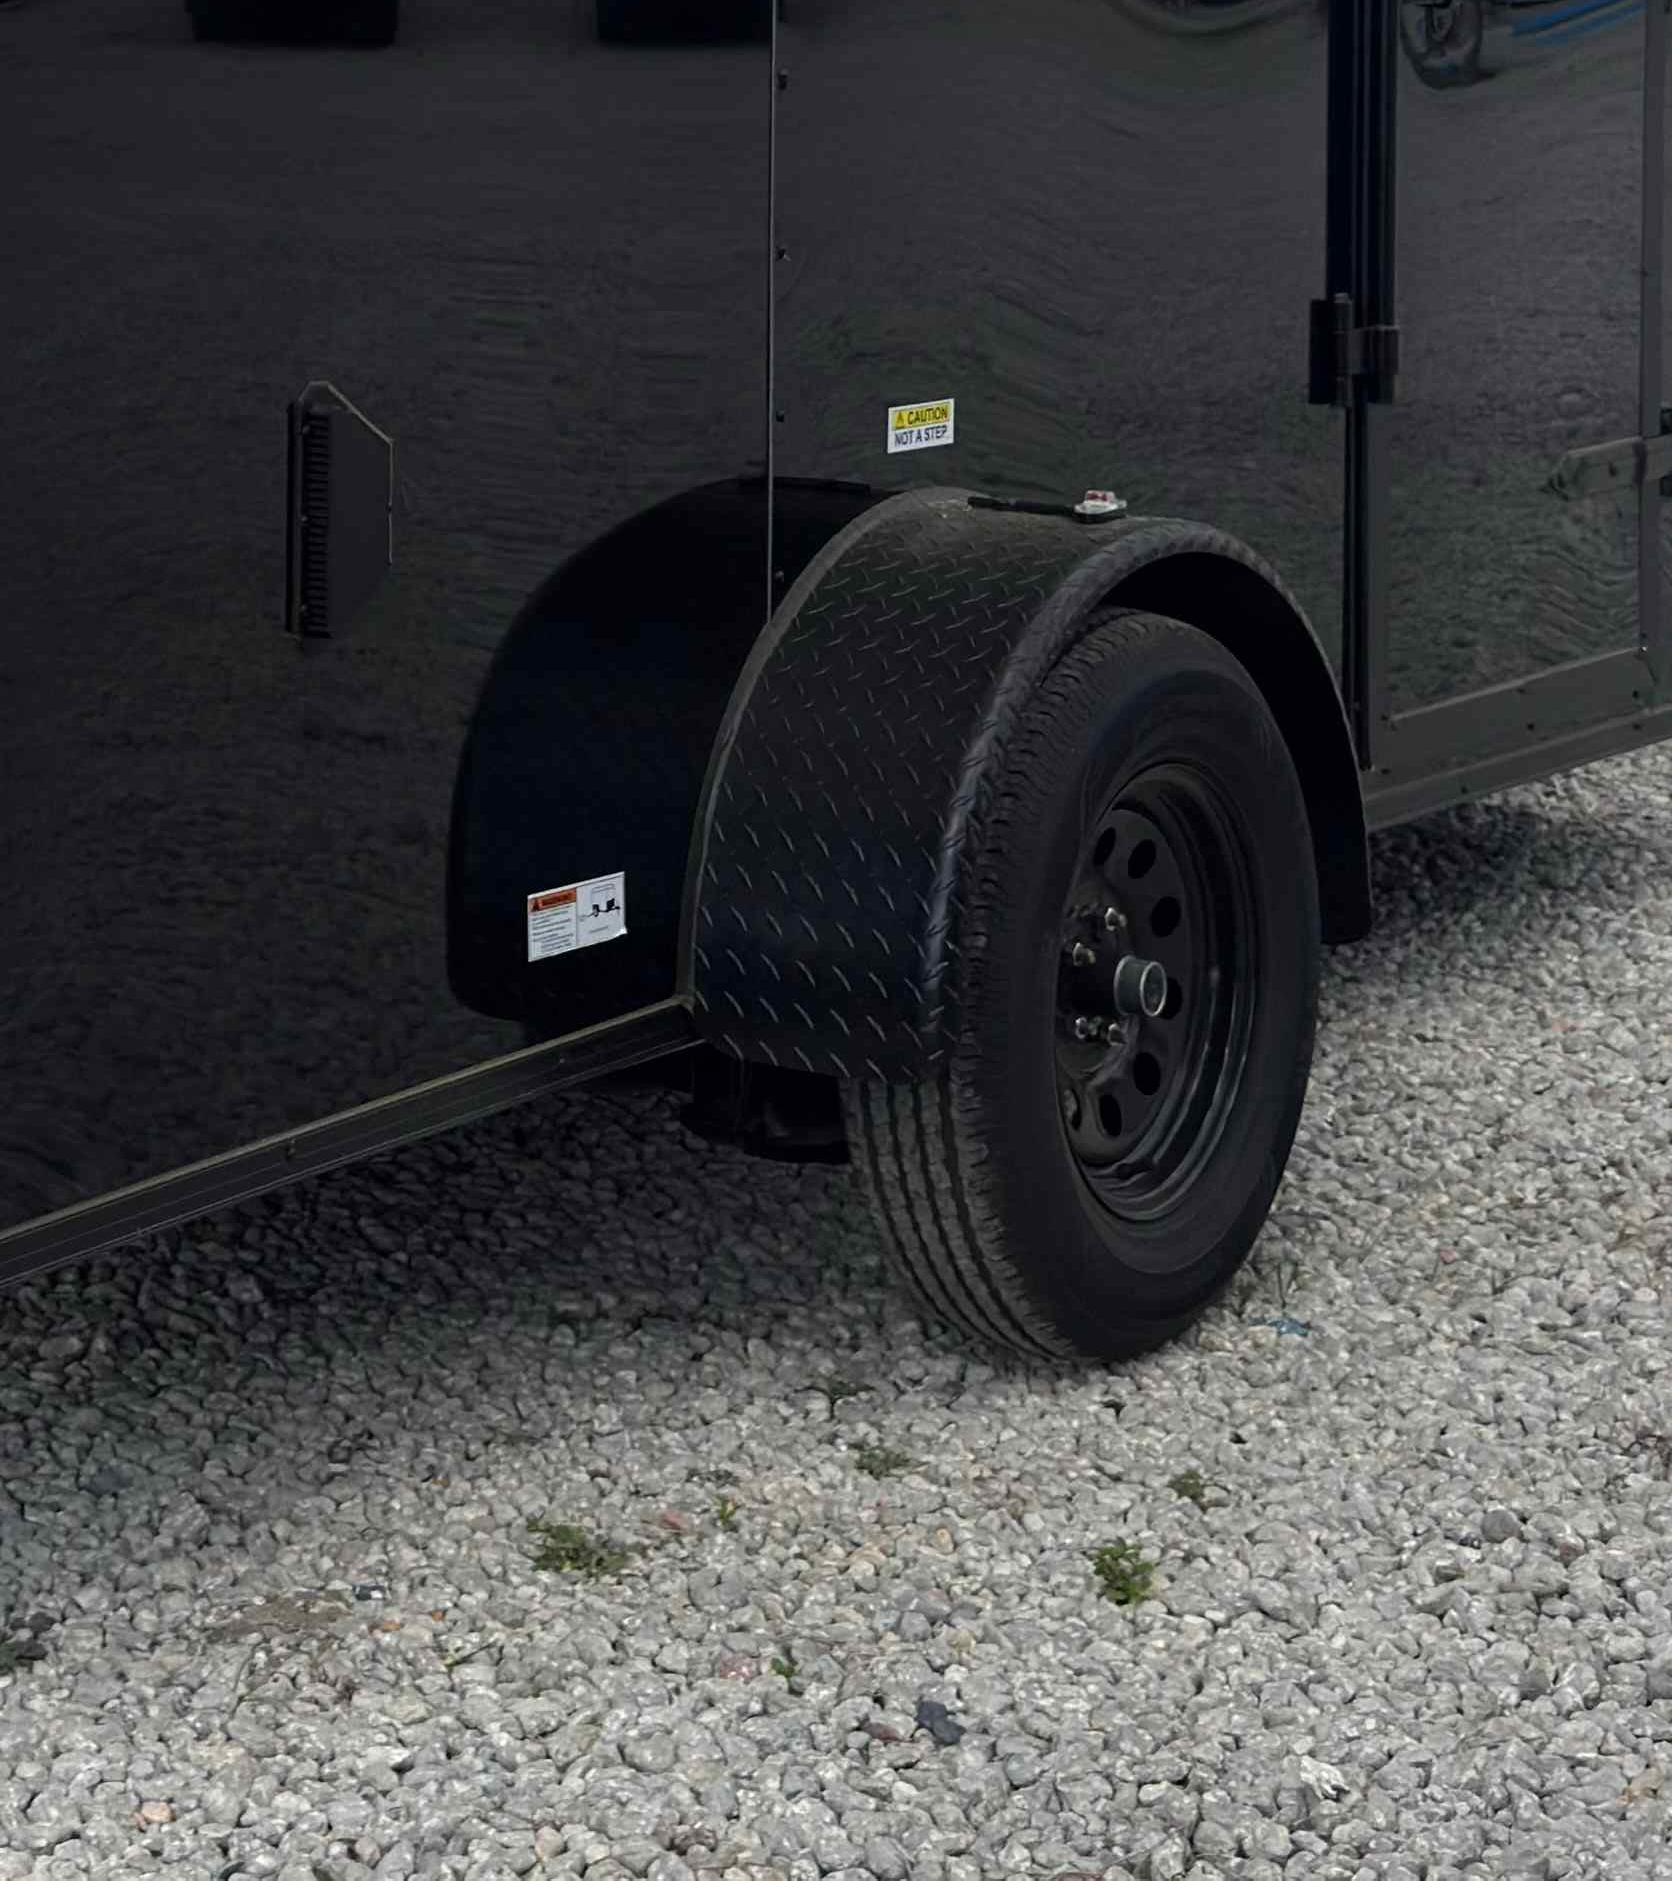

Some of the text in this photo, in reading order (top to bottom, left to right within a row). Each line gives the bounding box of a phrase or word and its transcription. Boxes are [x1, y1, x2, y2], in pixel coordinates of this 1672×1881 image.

[907, 407, 948, 425] CAUTION
[895, 425, 948, 446] NOT A STEP
